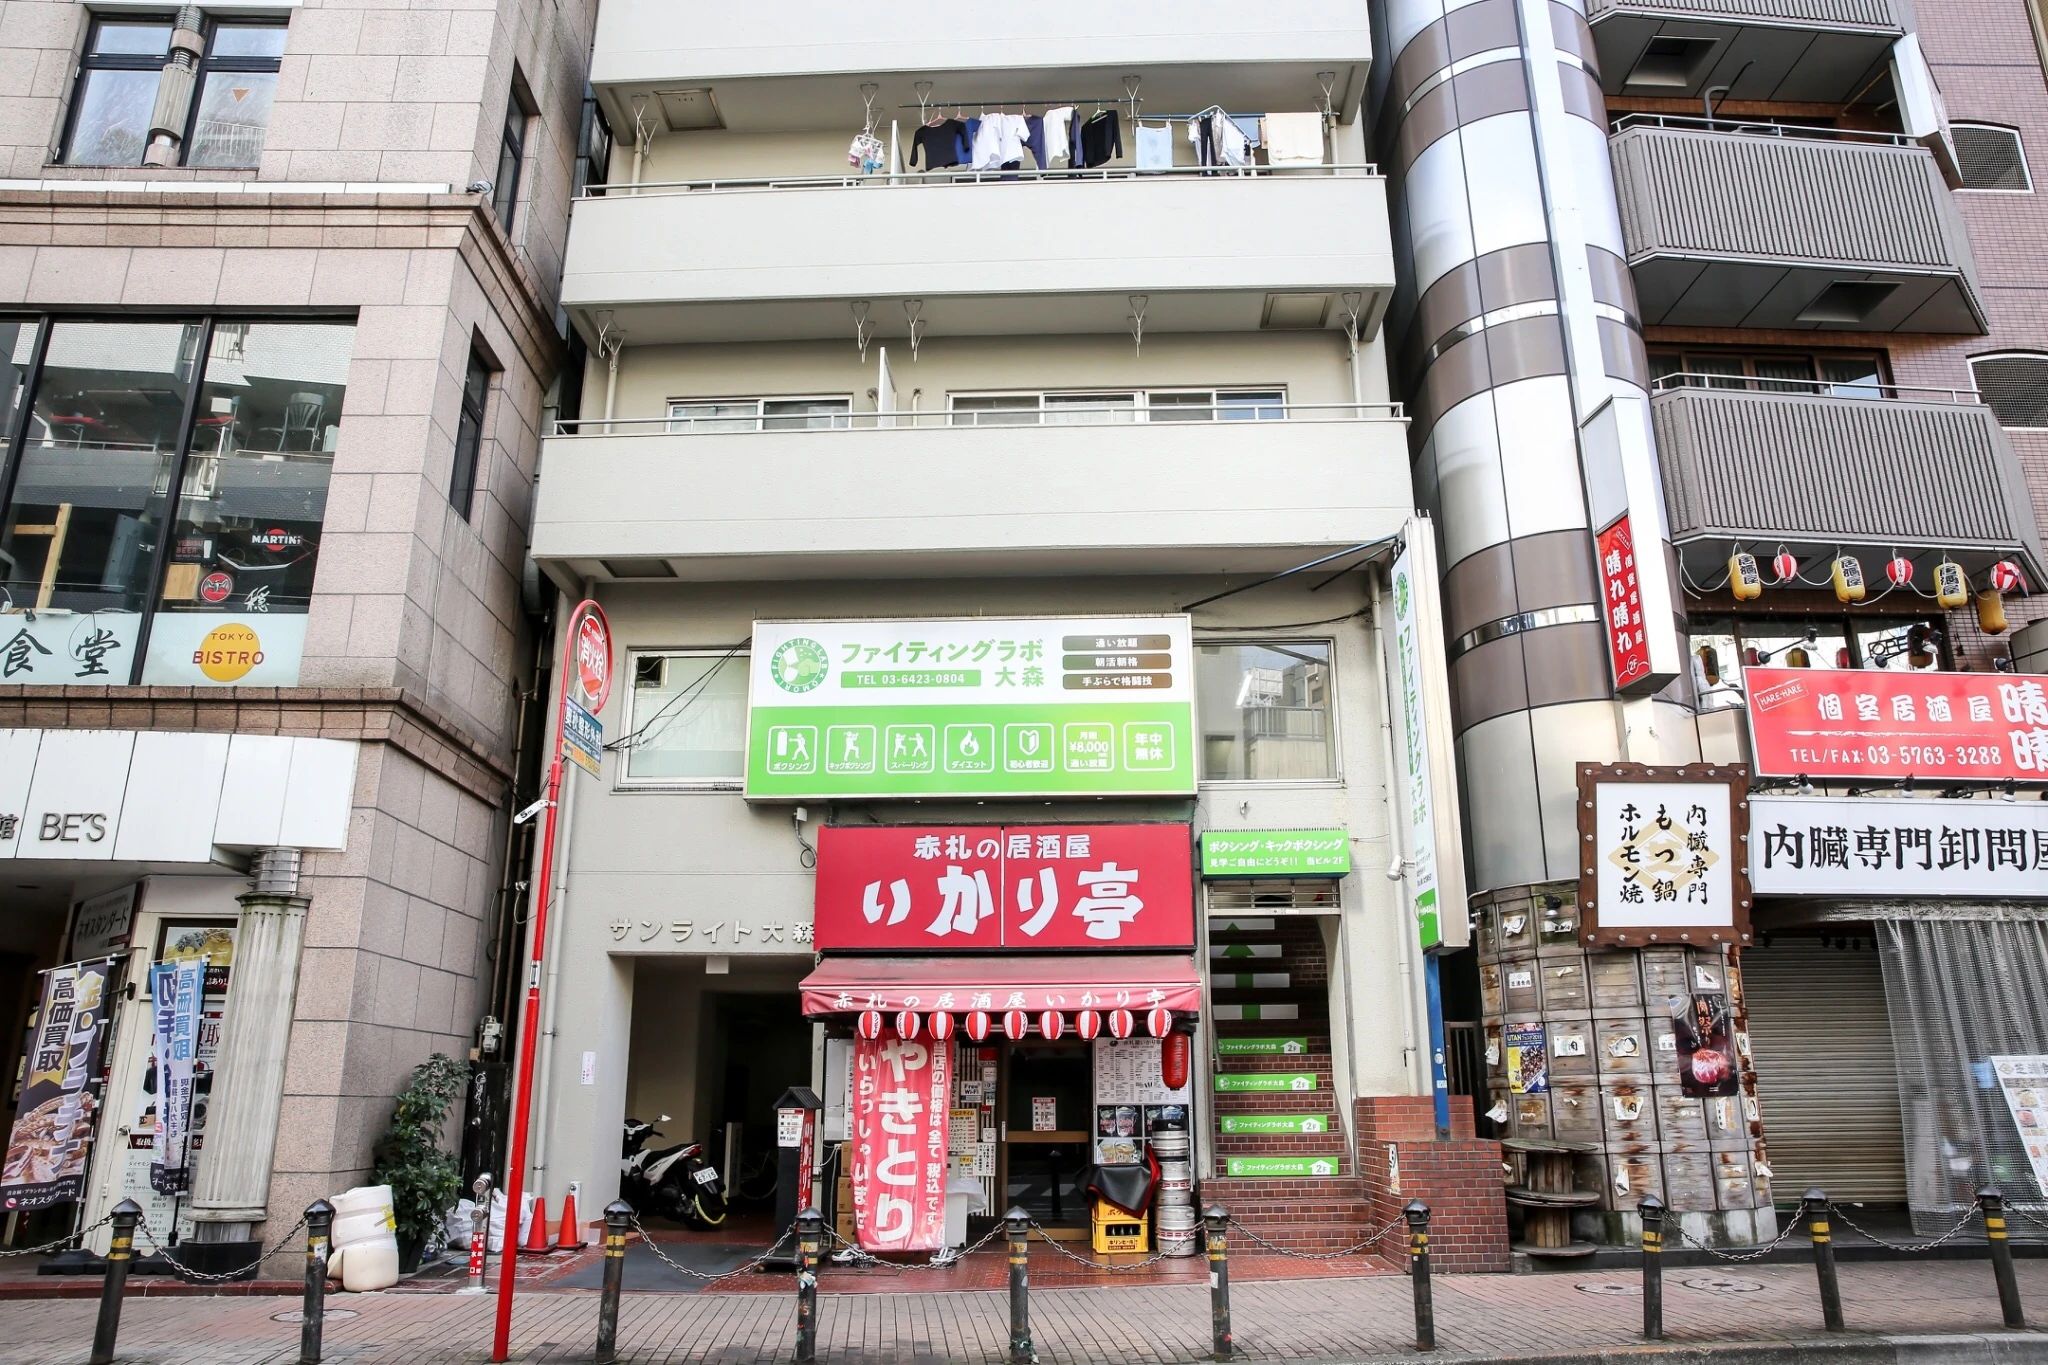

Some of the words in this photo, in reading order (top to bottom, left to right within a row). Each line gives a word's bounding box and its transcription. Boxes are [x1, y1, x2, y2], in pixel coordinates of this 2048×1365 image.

[1605, 549, 1633, 653] 晴れ晴れ
[1624, 553, 1644, 645] 個室居酒屋
[210, 632, 254, 641] TOKYO
[1095, 638, 1138, 648] 通い放題
[1872, 636, 1909, 655] OPE
[0, 627, 121, 678] 食堂
[192, 650, 264, 665] BISTRO
[841, 638, 1043, 664] ファイティングラボ
[857, 674, 876, 685] TEL
[882, 673, 965, 684] 03-6423-0804
[995, 666, 1044, 687] 大森
[1082, 676, 1152, 687] 手ぶらで格闘技
[1759, 684, 1804, 706] HARE-HARE
[1816, 693, 1995, 722] 個室居酒屋
[773, 761, 810, 770] ボクシング
[891, 760, 928, 769] スパーリング
[951, 759, 986, 769] ダイエット
[1867, 745, 2002, 766] 03-5763-3288
[913, 833, 1091, 860] 赤札の居酒屋
[1209, 838, 1344, 853] ボクシング・キックボクシング
[1619, 803, 1644, 904] ホルモン焼
[1651, 803, 1677, 903] もつ鍋
[1686, 804, 1710, 905] 内臓専門
[862, 861, 1145, 940] いかり亭
[610, 918, 815, 944] サンライト大森
[36, 977, 76, 1073] 高価買取
[853, 1053, 877, 1230] いらっしゃいませ
[876, 1039, 928, 1242] やきとり
[20, 1188, 75, 1206] ネオスタダード
